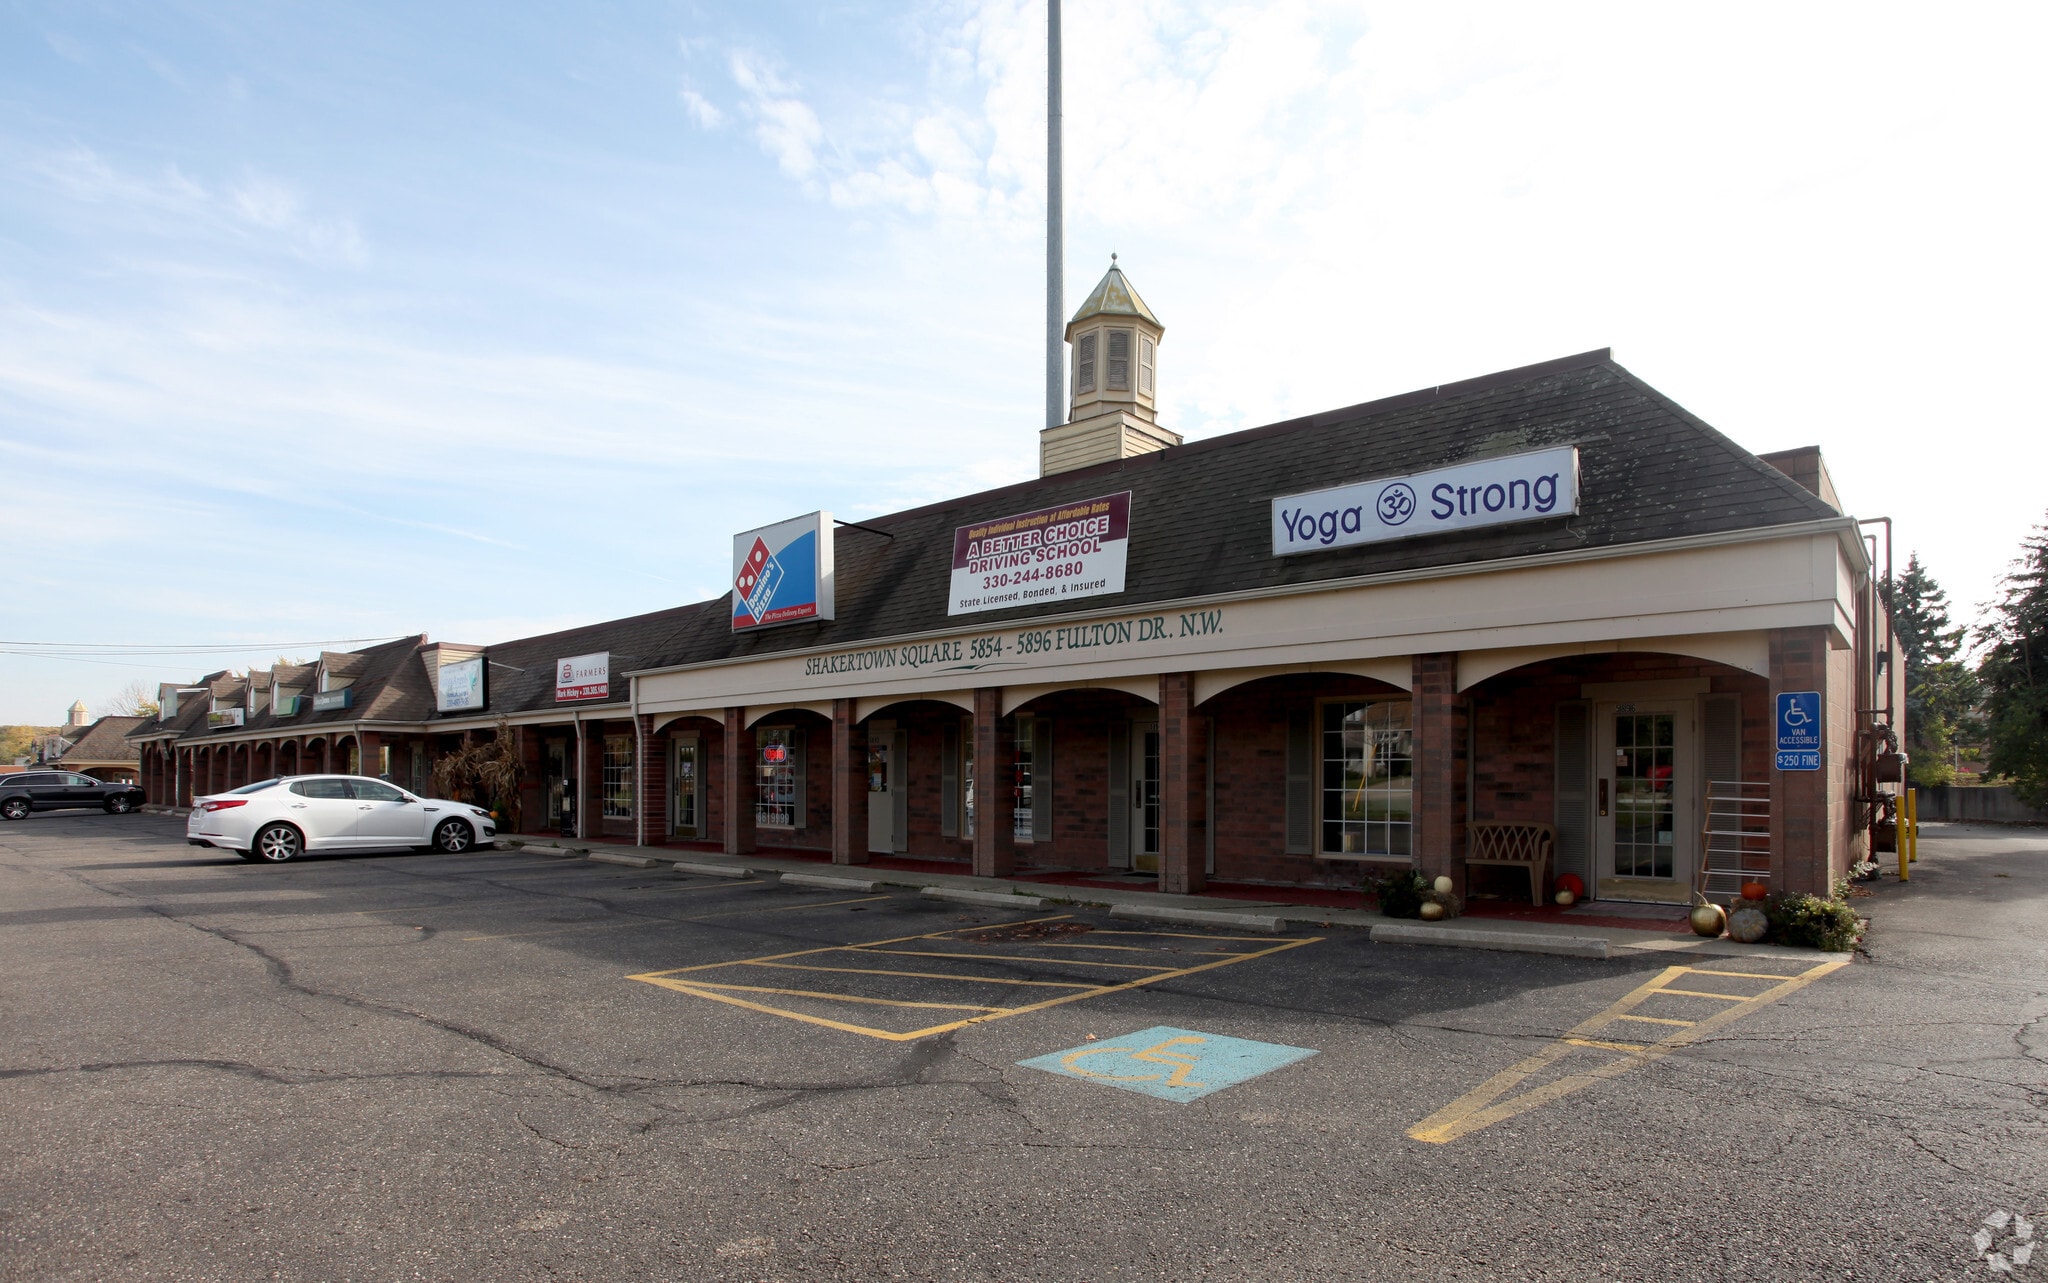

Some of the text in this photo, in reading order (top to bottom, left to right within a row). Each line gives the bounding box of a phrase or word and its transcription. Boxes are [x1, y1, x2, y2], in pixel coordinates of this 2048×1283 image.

[969, 502, 1110, 540] Quality Individual Instruction at Affordable Rates
[1281, 505, 1362, 545] Yoga
[1430, 472, 1559, 521] Strong
[968, 517, 1109, 558] A BETTER CHOICE
[969, 541, 1102, 575] DRIVING SCHOOL
[748, 561, 775, 618] Domino's Pizza
[983, 561, 1083, 590] 330-244-8680
[1023, 586, 1058, 599] Bonded,
[1061, 584, 1067, 593] &
[1070, 578, 1106, 592] Insured
[771, 611, 782, 619] Pizza
[782, 608, 797, 618] Delivery
[805, 647, 897, 676] SHAKERTOWN
[900, 640, 963, 666] SQUARE
[970, 636, 1003, 659] 5854
[1016, 630, 1052, 654] 5896
[1055, 619, 1133, 651] FULTON
[1138, 617, 1173, 643] DR.
[1180, 609, 1224, 638] N.W.
[576, 667, 606, 678] FARMERS
[1779, 736, 1818, 744] ACCESSIBLE
[1791, 728, 1806, 736] VAN
[1777, 754, 1818, 766] $250 FINE
